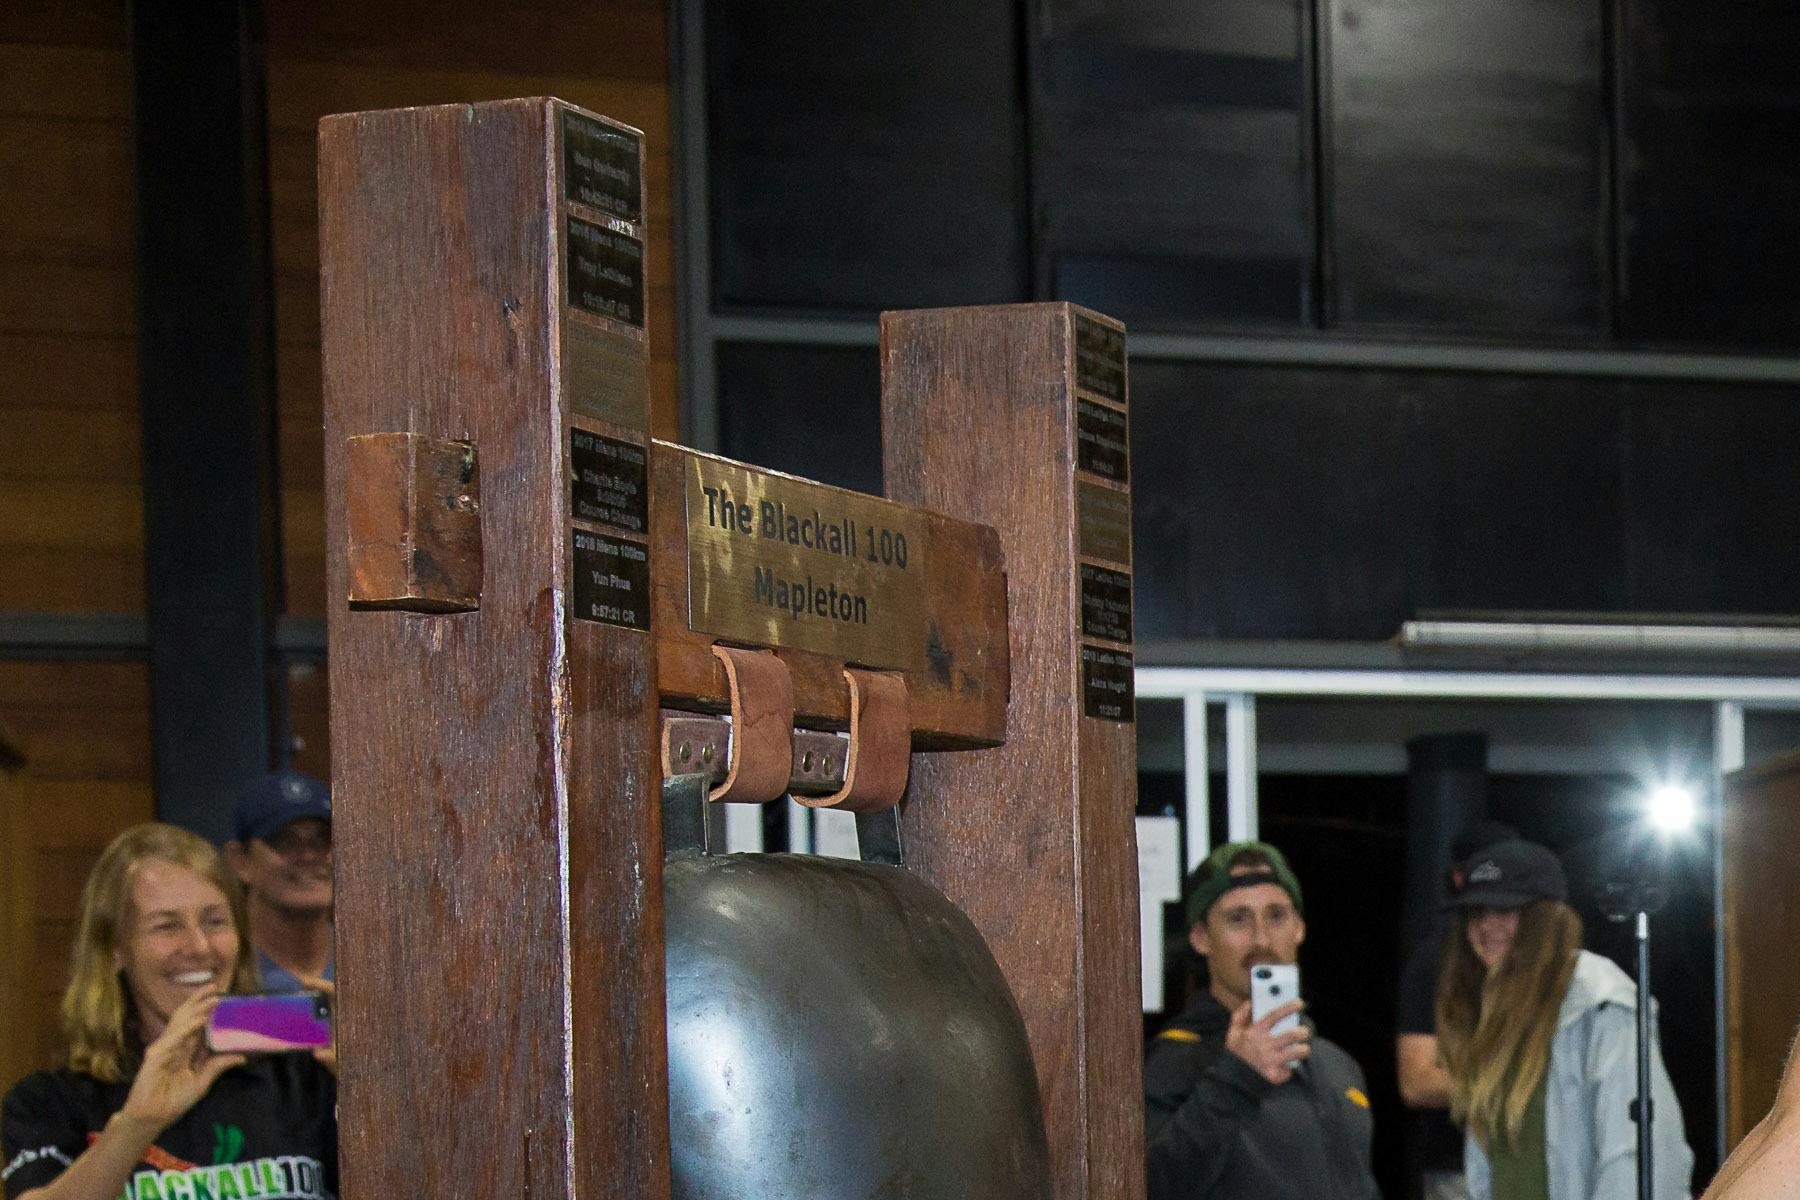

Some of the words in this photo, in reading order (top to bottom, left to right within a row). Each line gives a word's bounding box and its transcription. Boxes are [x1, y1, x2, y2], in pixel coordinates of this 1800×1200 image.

[703, 486, 752, 534] The
[761, 500, 857, 559] Blackall
[867, 525, 908, 570] 100
[592, 570, 608, 586] Yun
[753, 565, 868, 625] Mapleton
[622, 608, 634, 623] CR
